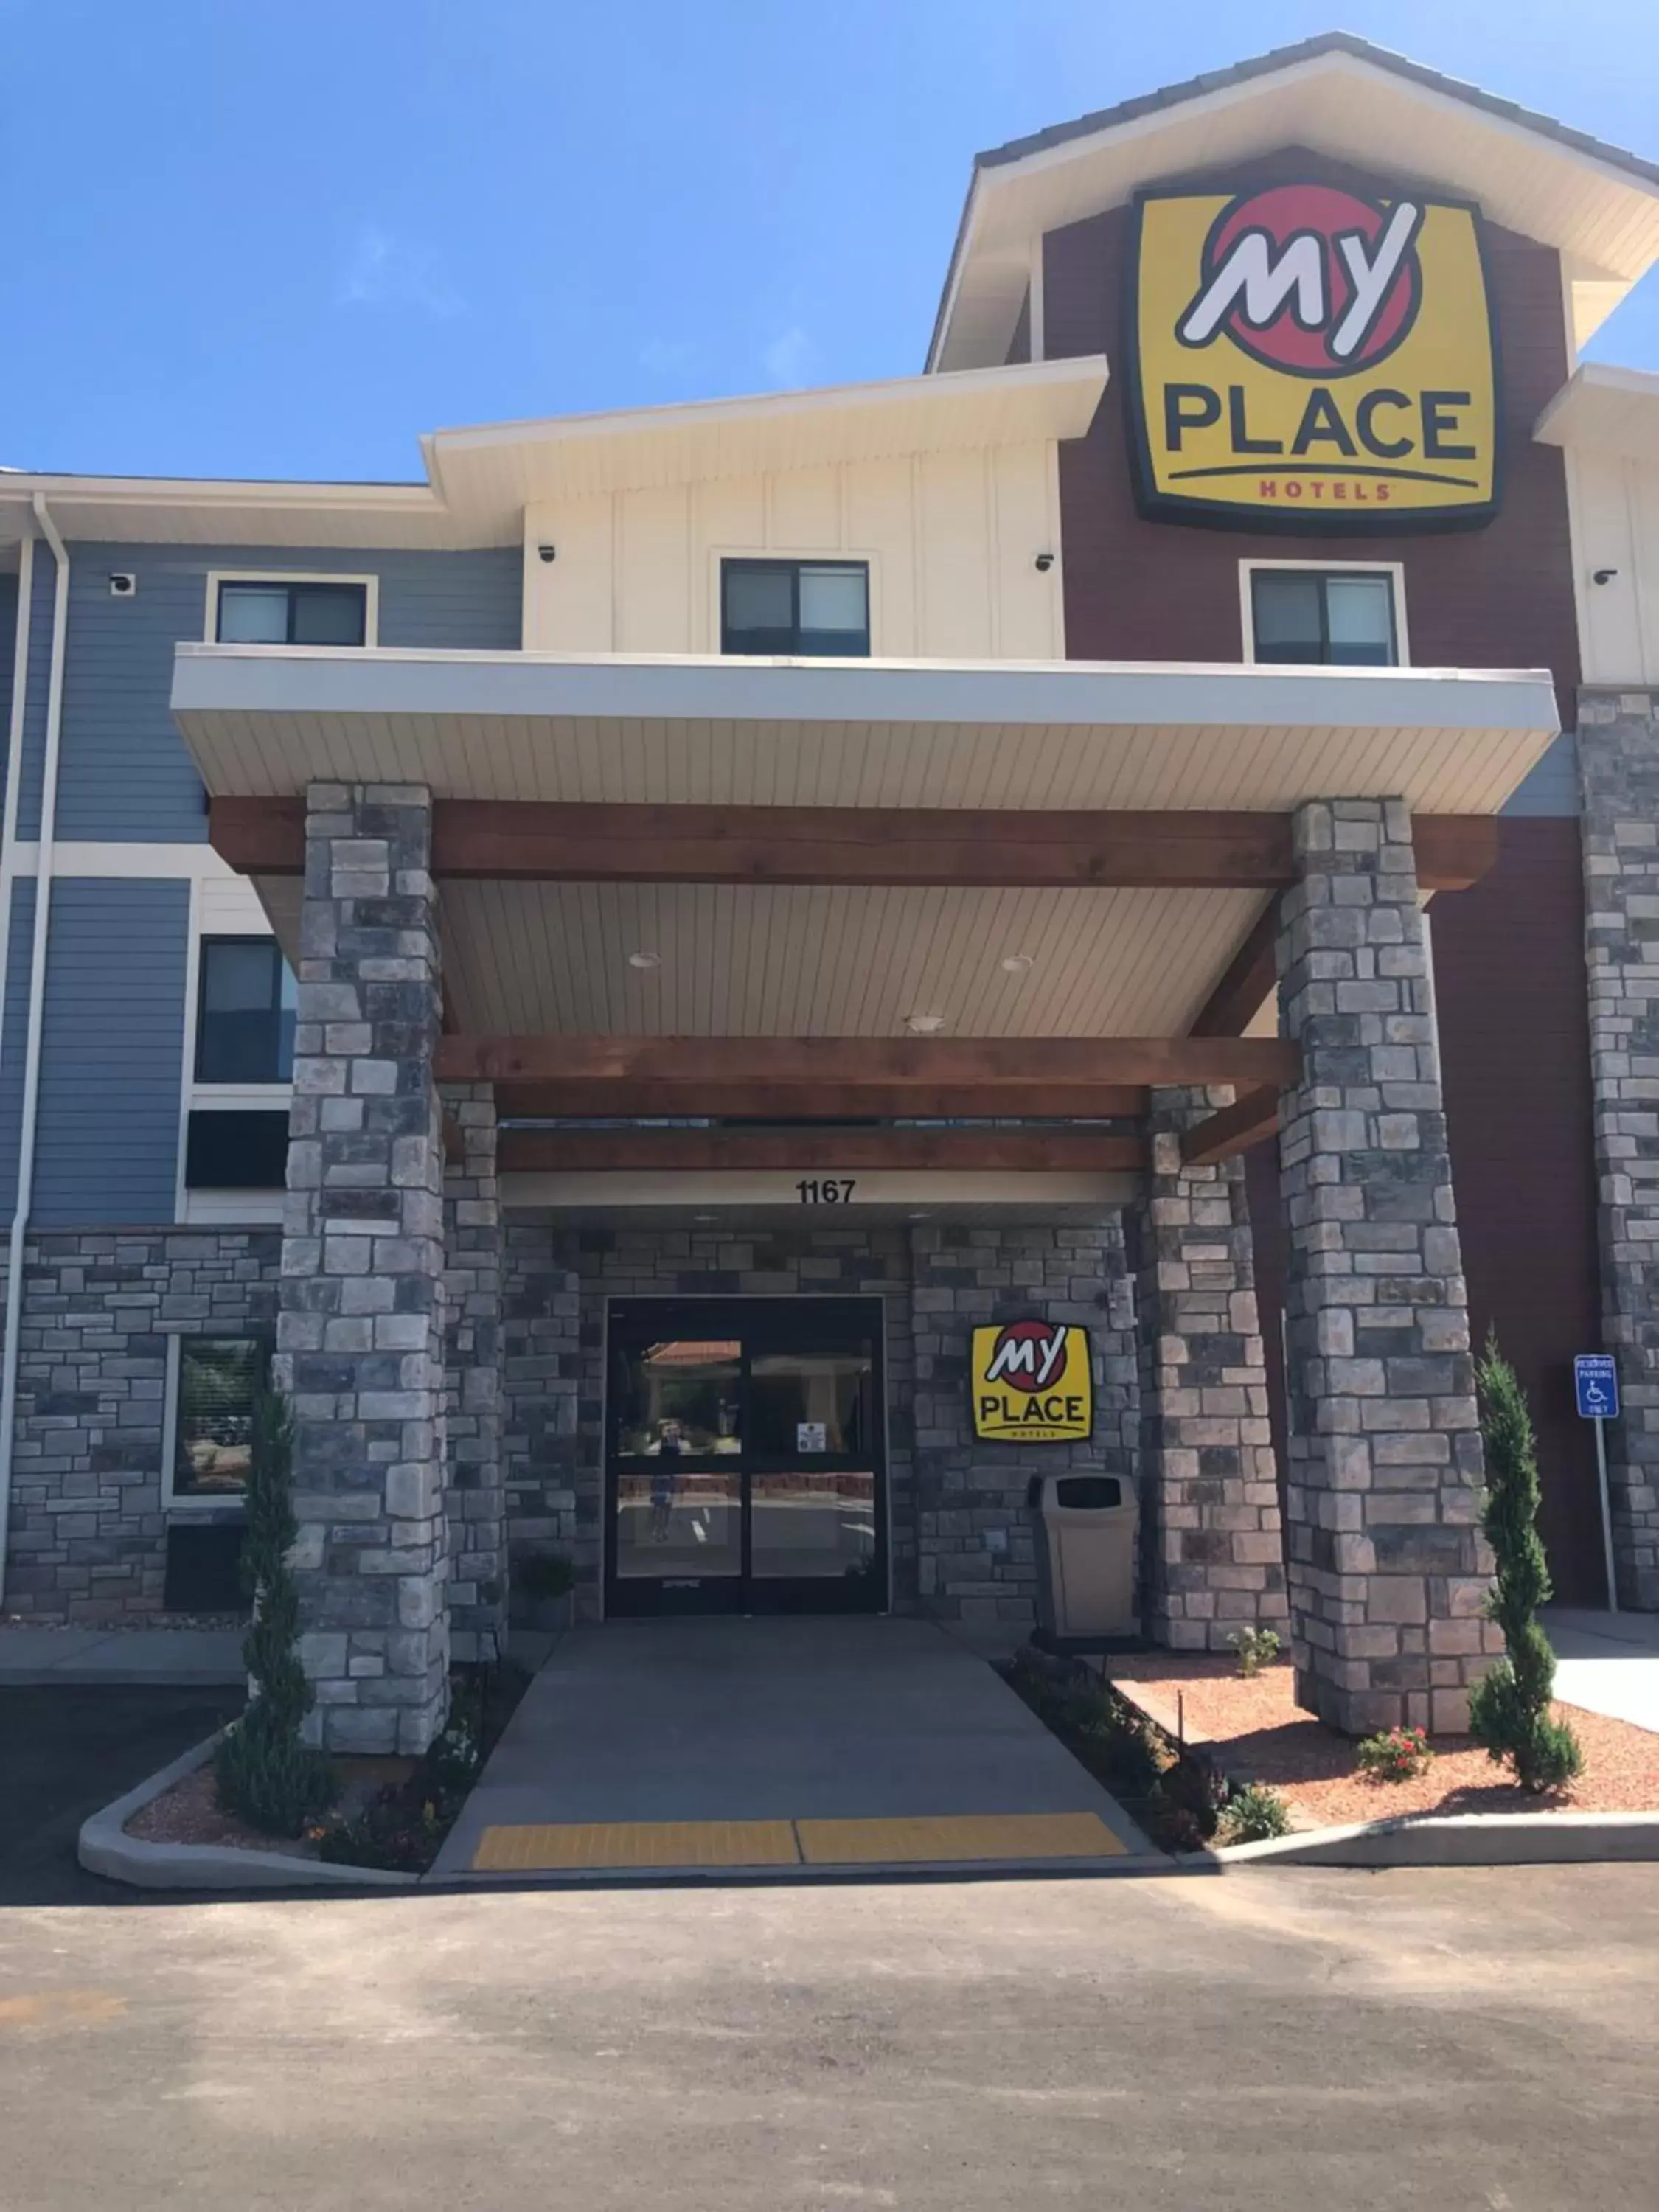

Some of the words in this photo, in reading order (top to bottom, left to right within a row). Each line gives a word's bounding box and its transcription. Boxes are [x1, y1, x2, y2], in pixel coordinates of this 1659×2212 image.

[1163, 383, 1478, 461] PLACE
[1259, 481, 1391, 501] HOTELS
[796, 1180, 856, 1203] 1167
[980, 1396, 1085, 1422] PLACE
